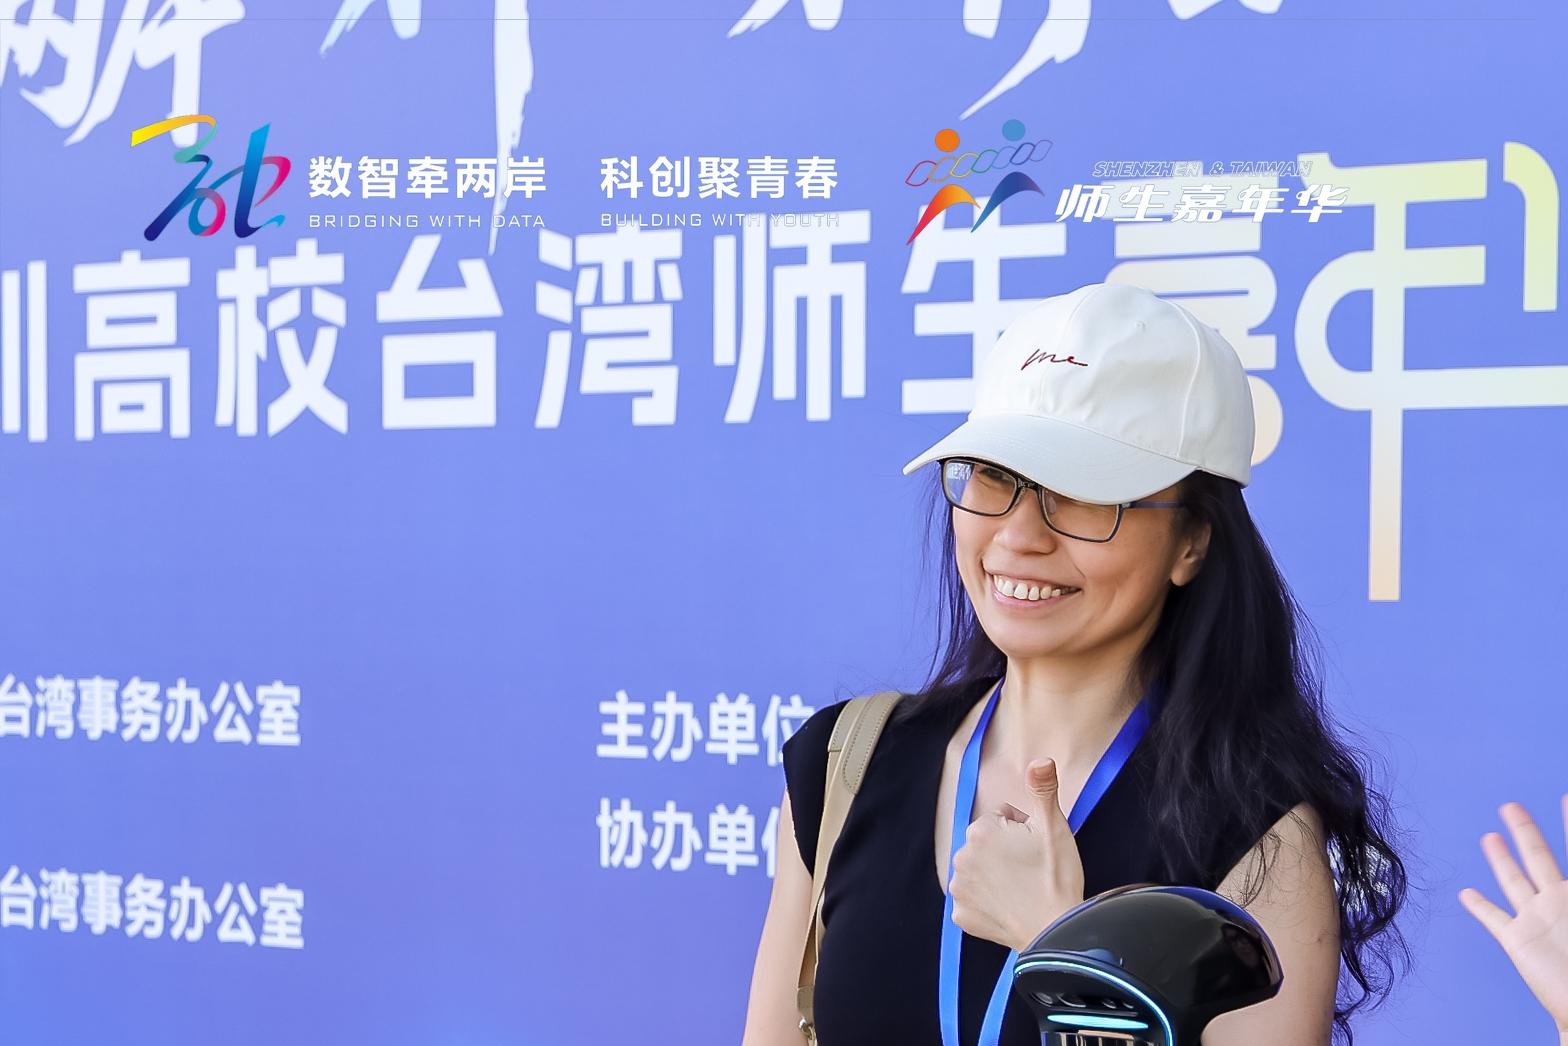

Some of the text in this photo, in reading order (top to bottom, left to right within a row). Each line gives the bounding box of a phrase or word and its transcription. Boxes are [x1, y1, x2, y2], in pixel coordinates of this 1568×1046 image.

[0, 673, 300, 746] 台湾事务办公室
[0, 865, 304, 949] 台湾事务办公室
